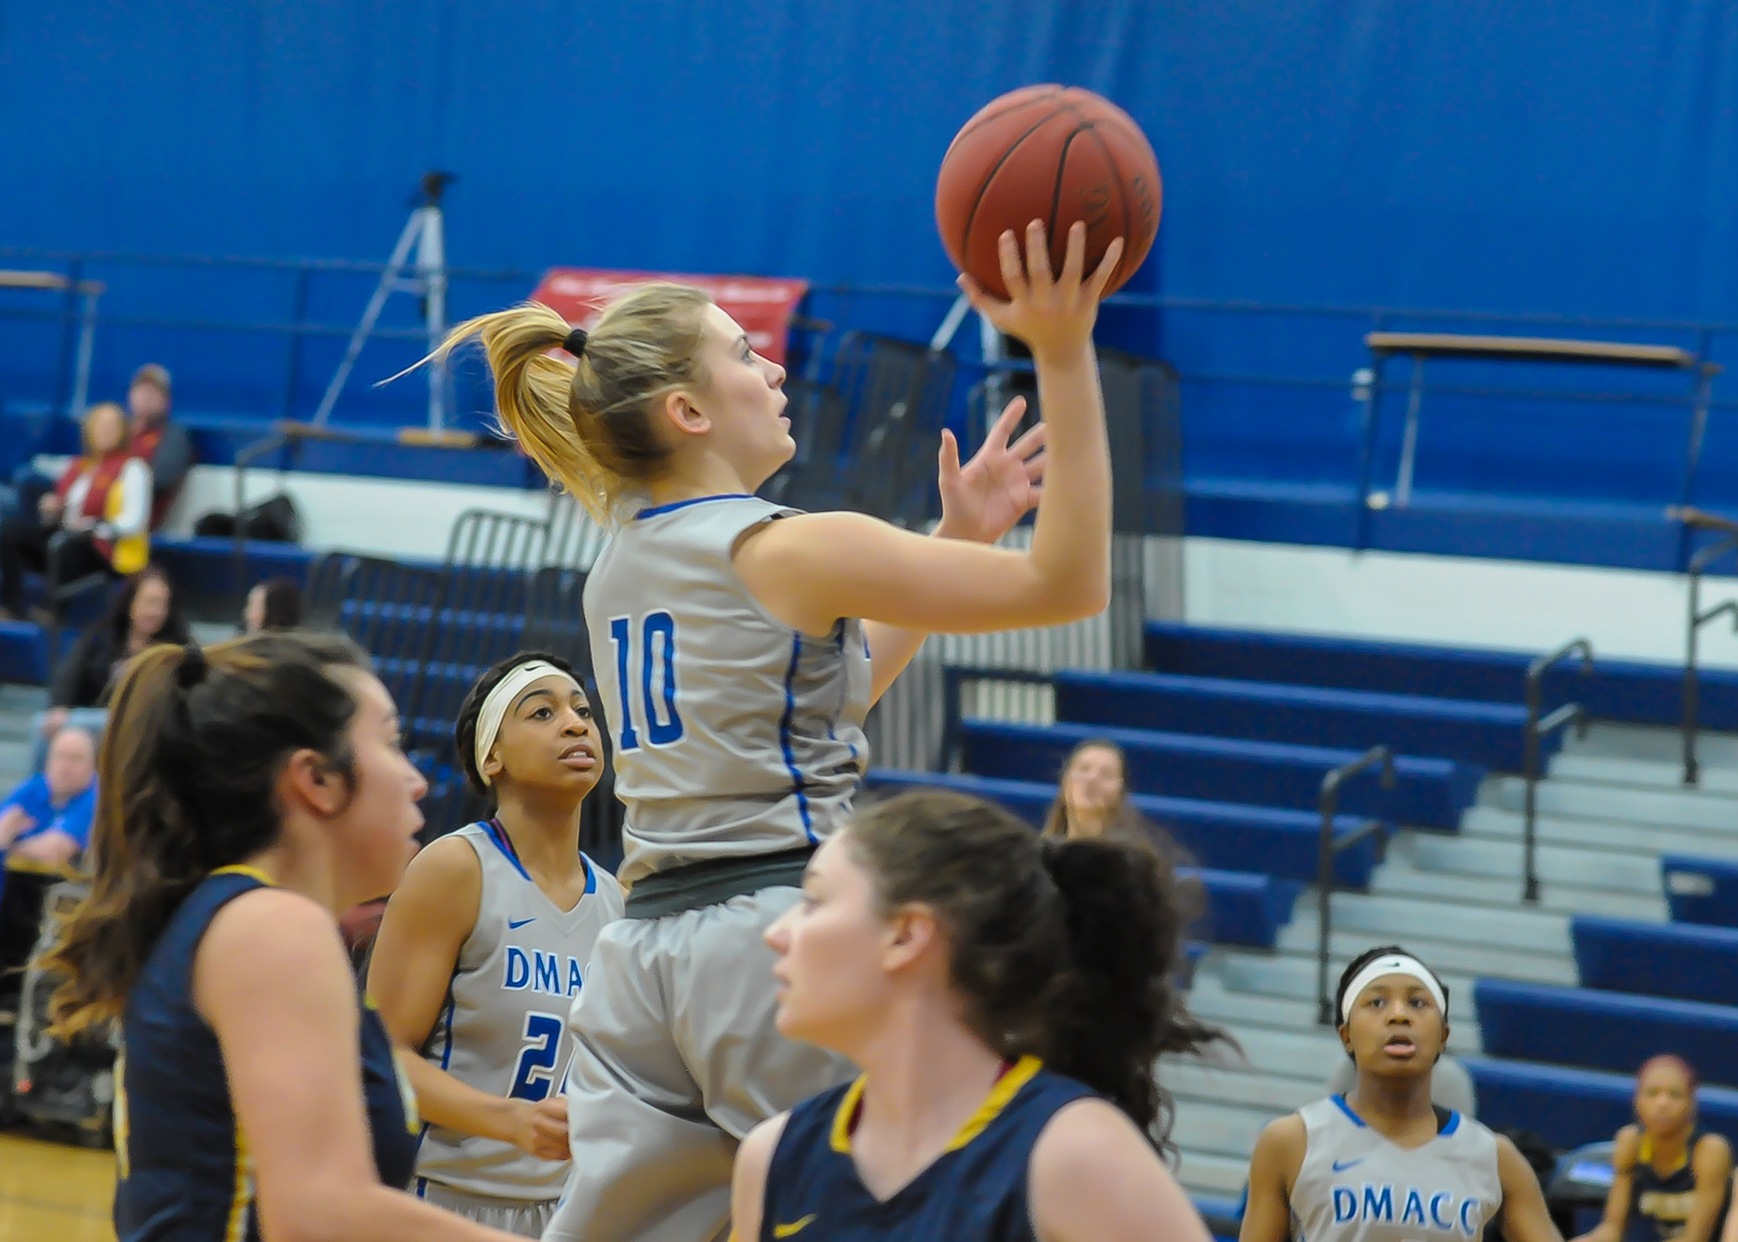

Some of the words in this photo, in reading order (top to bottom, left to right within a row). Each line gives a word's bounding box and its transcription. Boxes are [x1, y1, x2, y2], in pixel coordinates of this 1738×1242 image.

[609, 609, 686, 753] 10
[502, 946, 590, 998] DMA
[508, 1011, 576, 1101] 2
[1332, 1183, 1481, 1236] DMACC
